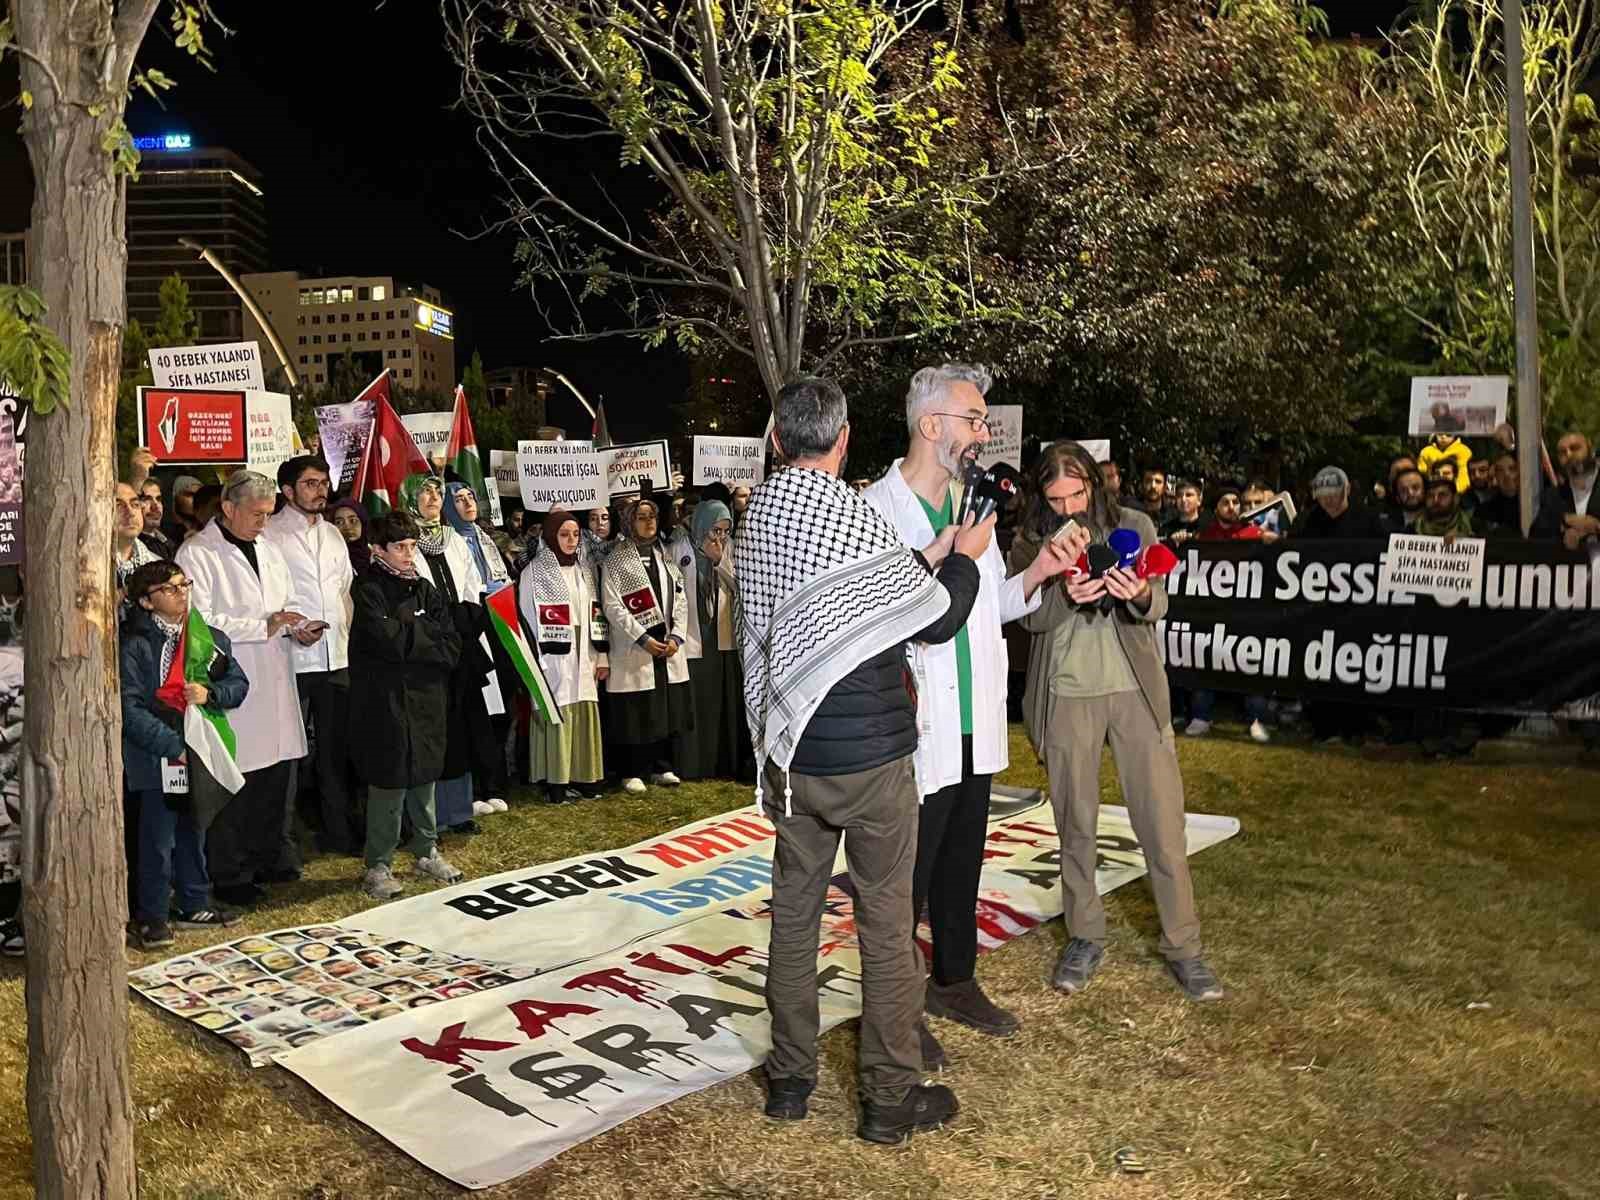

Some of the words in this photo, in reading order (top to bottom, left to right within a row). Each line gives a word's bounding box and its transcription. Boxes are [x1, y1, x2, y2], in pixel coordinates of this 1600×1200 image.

[157, 355, 171, 368] 40
[173, 352, 208, 366] BEBEK
[210, 348, 255, 364] YALANDI
[194, 364, 250, 384] HASTANESİ
[742, 442, 761, 460] İŞGAL
[524, 460, 574, 477] HASTANELERİ
[576, 460, 600, 480] İŞGAL
[608, 459, 658, 473] SOYKIRIM
[557, 488, 597, 506] SUÇUDUR
[1393, 540, 1406, 551] 40
[1407, 540, 1437, 553] BEBEK
[1439, 543, 1480, 557] YALANDI
[1398, 555, 1417, 569] ŞİFA
[1420, 558, 1470, 572] HASTANESİ
[1163, 549, 1264, 599] rken
[1436, 576, 1473, 592] GERÇEK
[1155, 619, 1292, 678] lürken
[1304, 629, 1449, 694] değil!
[170, 777, 187, 786] MİL
[446, 856, 659, 920] BEBEK
[634, 814, 777, 868] KATİL
[400, 944, 757, 1073] KATİL
